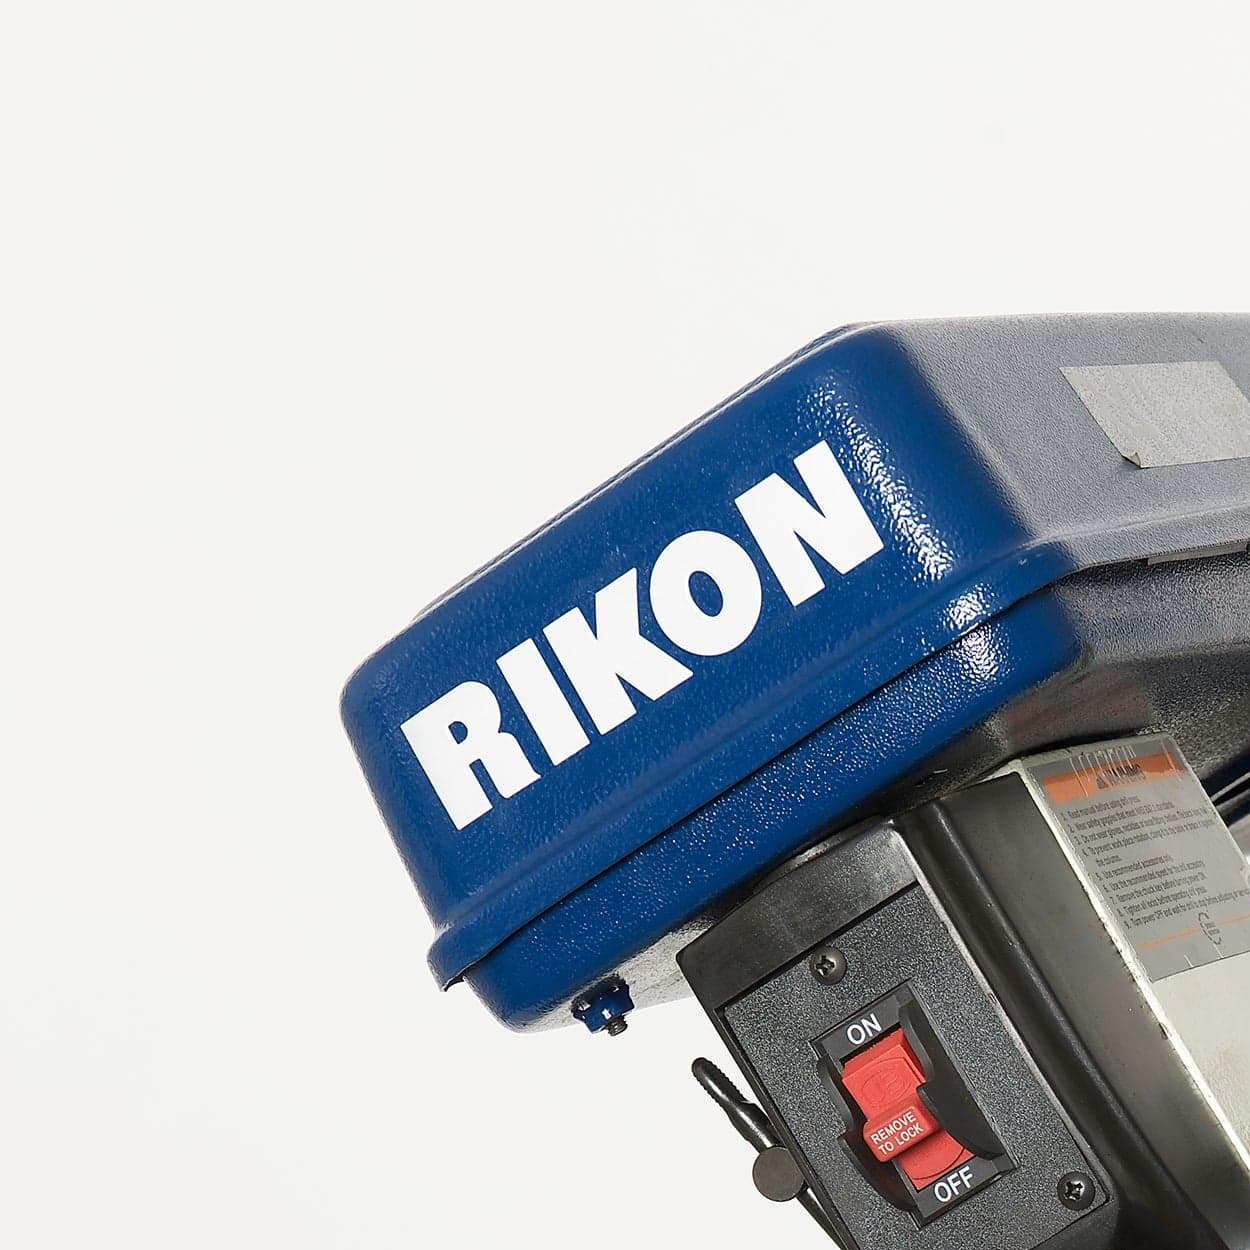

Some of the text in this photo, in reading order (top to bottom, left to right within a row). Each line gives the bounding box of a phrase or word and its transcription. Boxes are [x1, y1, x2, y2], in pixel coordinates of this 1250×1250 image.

[400, 440, 884, 830] RIKON
[846, 1013, 882, 1045] ON
[870, 1111, 917, 1145] REMOVE
[878, 1122, 924, 1156] TO LOCK
[934, 1165, 974, 1202] OFF
